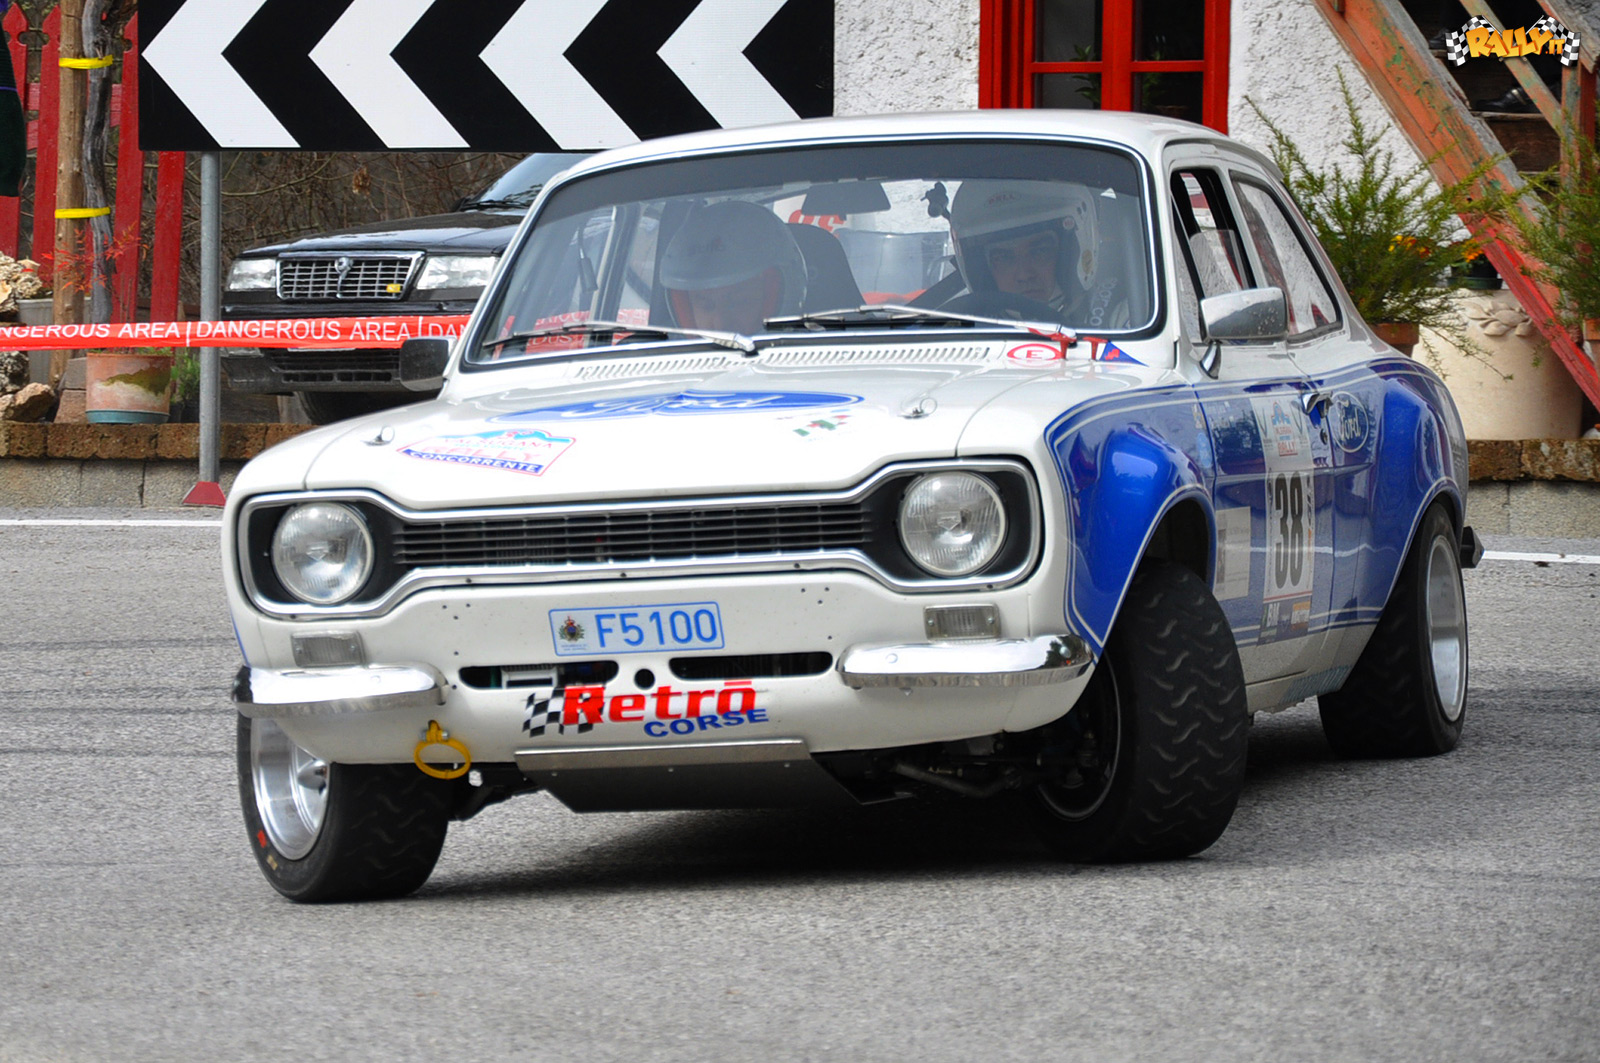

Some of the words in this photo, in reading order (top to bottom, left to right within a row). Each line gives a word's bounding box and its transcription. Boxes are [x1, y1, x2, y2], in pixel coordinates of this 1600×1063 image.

[118, 322, 180, 338] AREA
[196, 320, 341, 340] DANGEROUS
[350, 322, 411, 341] AREA
[1336, 399, 1361, 441] Ford
[410, 451, 538, 473] CONCORRENTE
[1275, 472, 1303, 589] 38
[595, 609, 718, 648] F5100
[644, 708, 769, 738] CORSE
